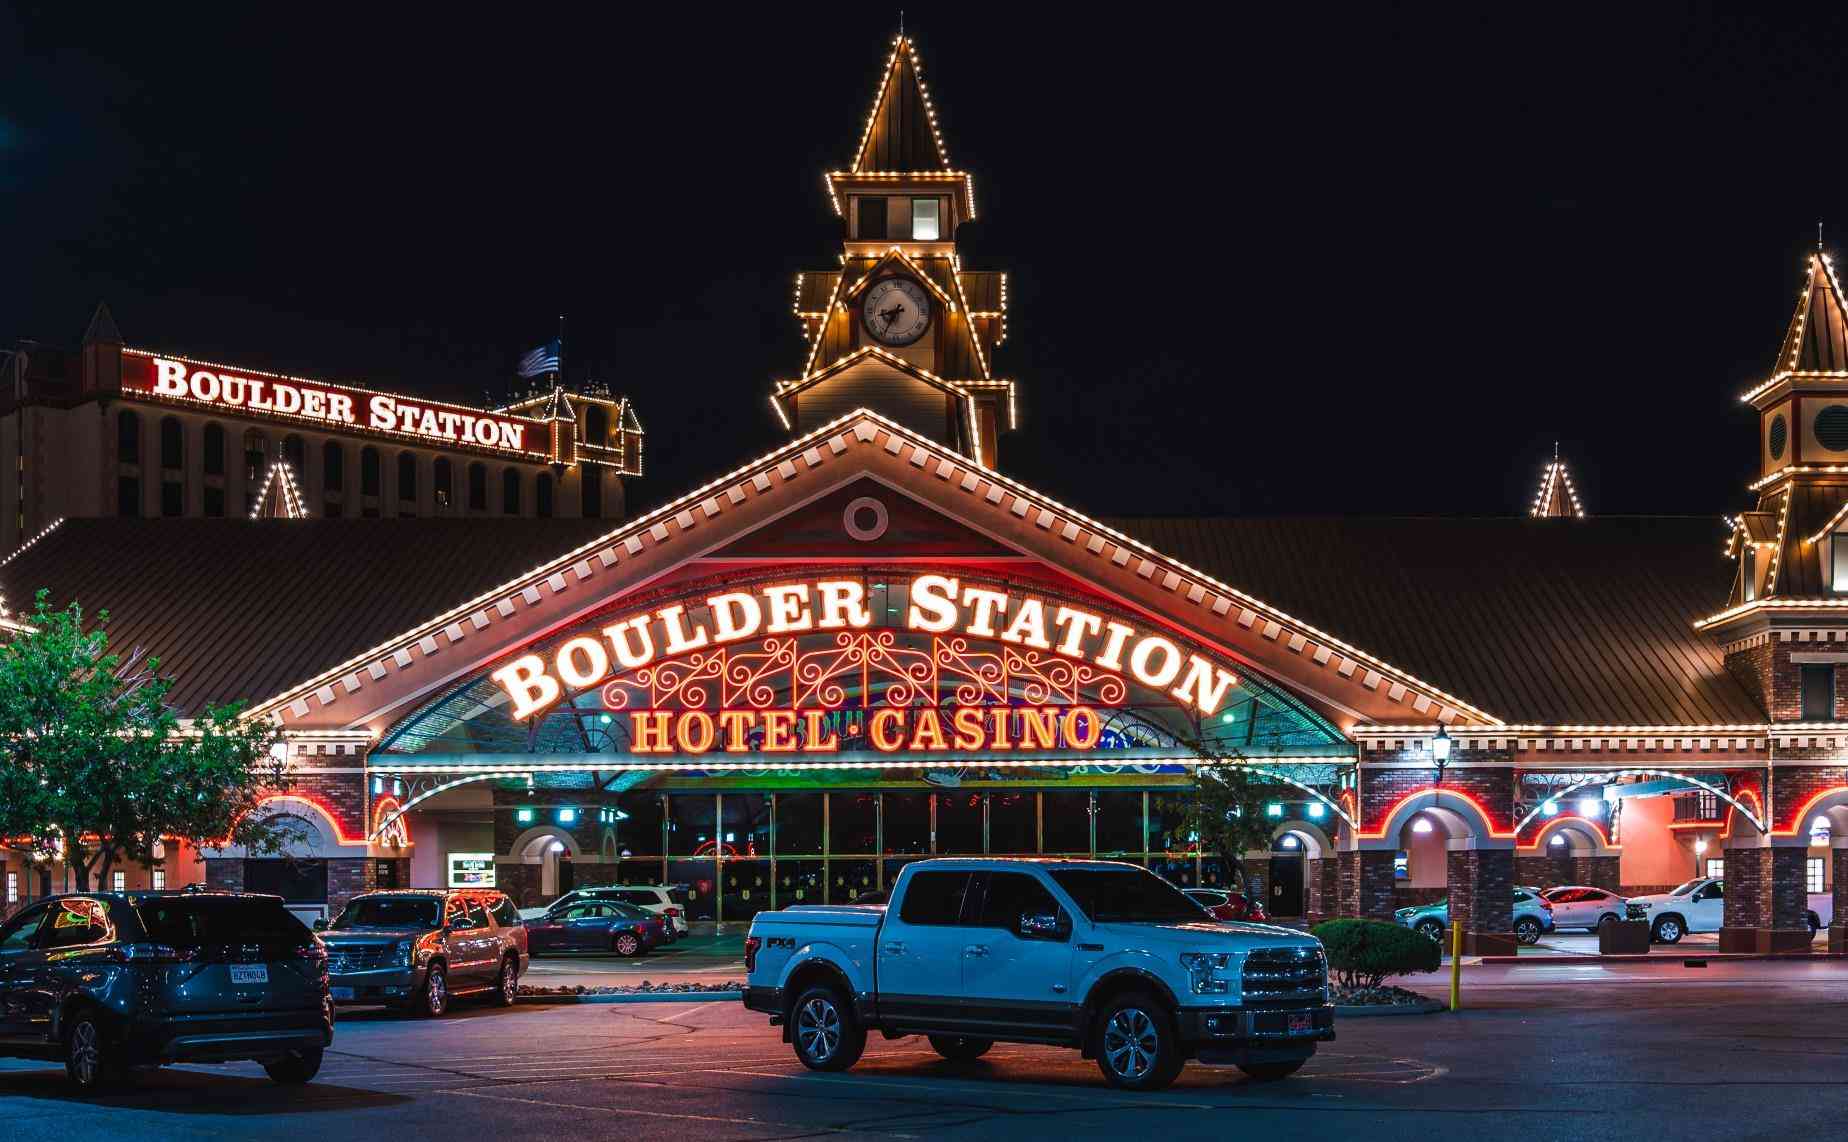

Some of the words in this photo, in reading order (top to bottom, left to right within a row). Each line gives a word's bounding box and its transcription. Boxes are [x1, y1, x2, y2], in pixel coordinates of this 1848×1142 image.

[153, 358, 356, 424] BOULDER
[369, 396, 525, 450] STATION
[491, 580, 871, 722] BOULDER
[908, 573, 1239, 716] STATION
[630, 709, 839, 753] HOTEL
[870, 707, 1102, 751] CASINO
[767, 937, 795, 949] FX4
